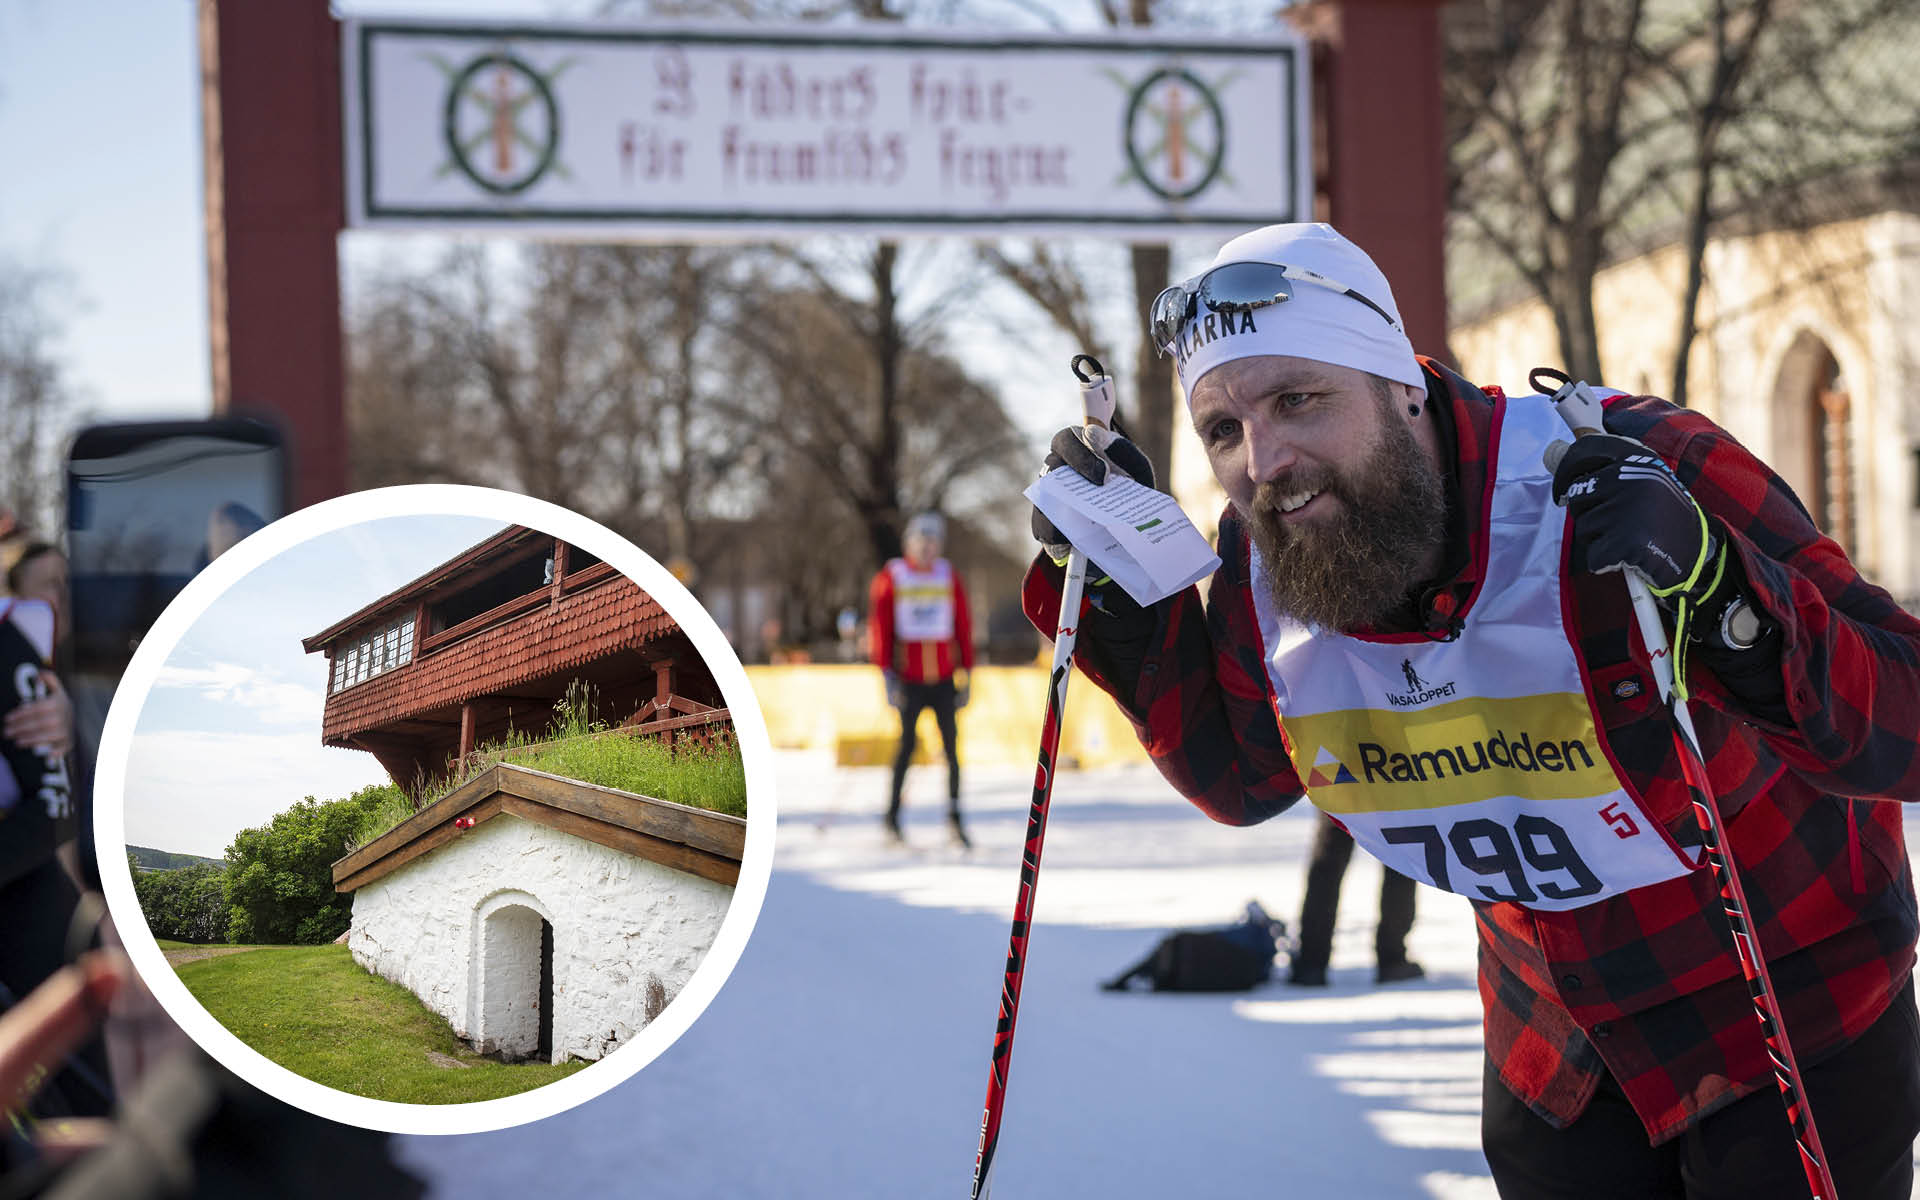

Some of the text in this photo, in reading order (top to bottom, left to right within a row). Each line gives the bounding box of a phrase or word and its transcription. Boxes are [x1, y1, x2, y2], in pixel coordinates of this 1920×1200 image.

[1177, 310, 1257, 377] ALARNA
[1567, 477, 1598, 498] ort
[1385, 681, 1457, 706] VASALOPPET
[1357, 729, 1595, 784] Ramudden
[1597, 801, 1641, 840] 5
[1380, 813, 1604, 902] 799
